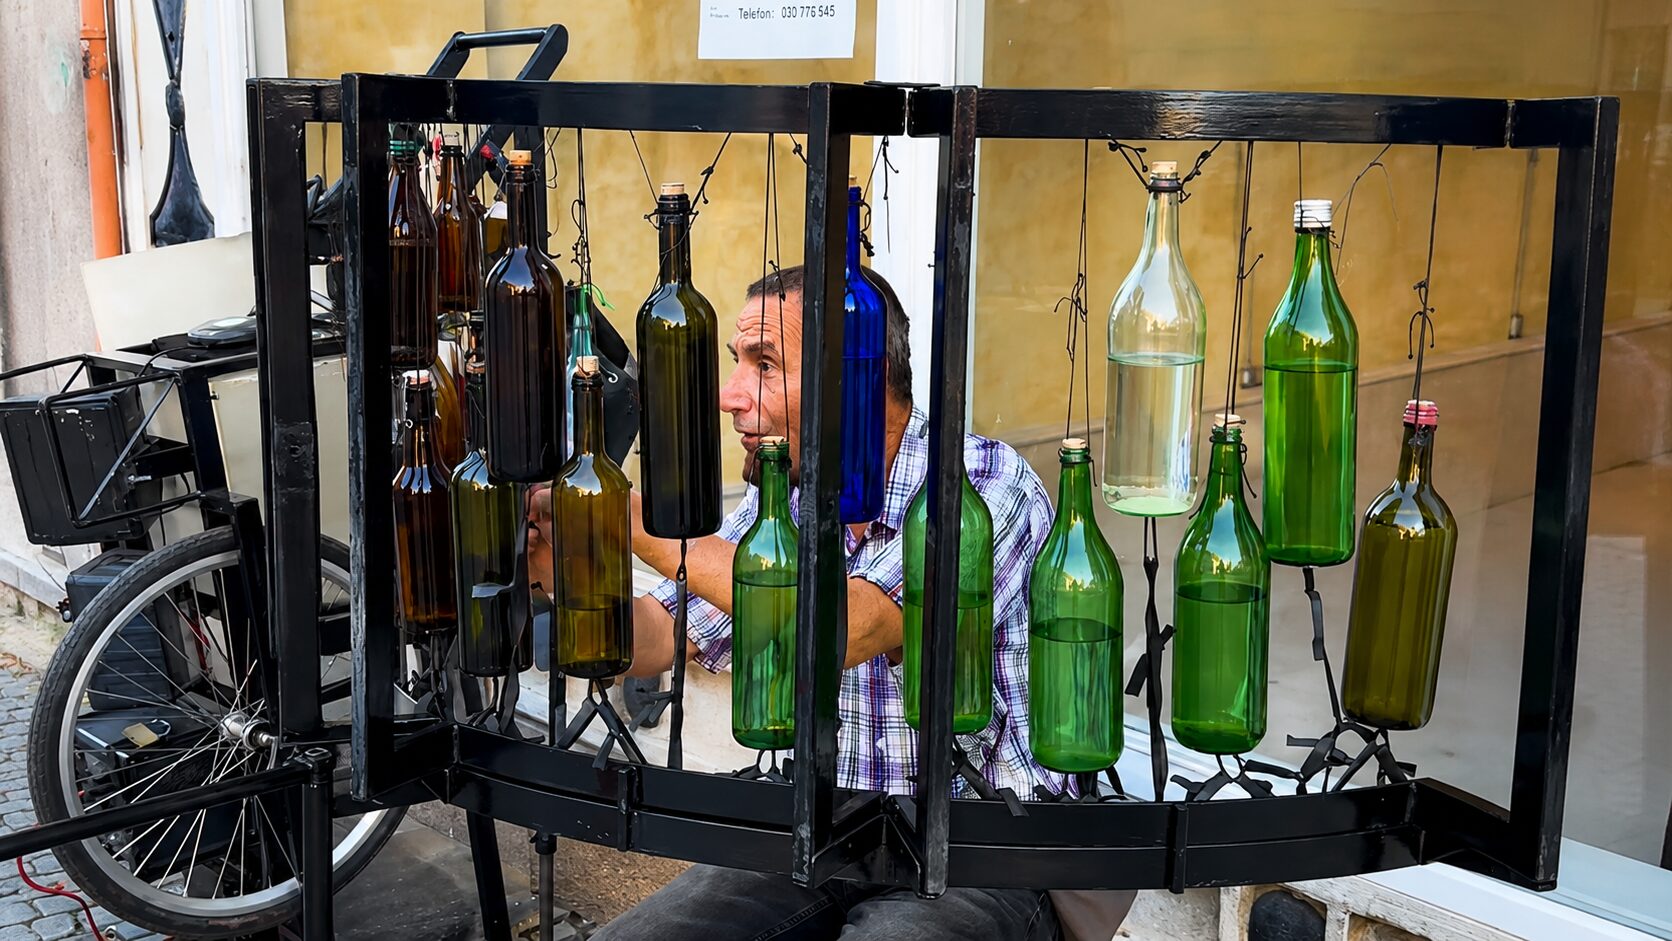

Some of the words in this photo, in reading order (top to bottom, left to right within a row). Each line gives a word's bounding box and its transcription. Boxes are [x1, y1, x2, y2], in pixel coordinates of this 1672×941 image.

[738, 7, 775, 19] Telefon:
[781, 6, 798, 18] 030
[800, 6, 816, 18] 776
[818, 5, 836, 17] 545
